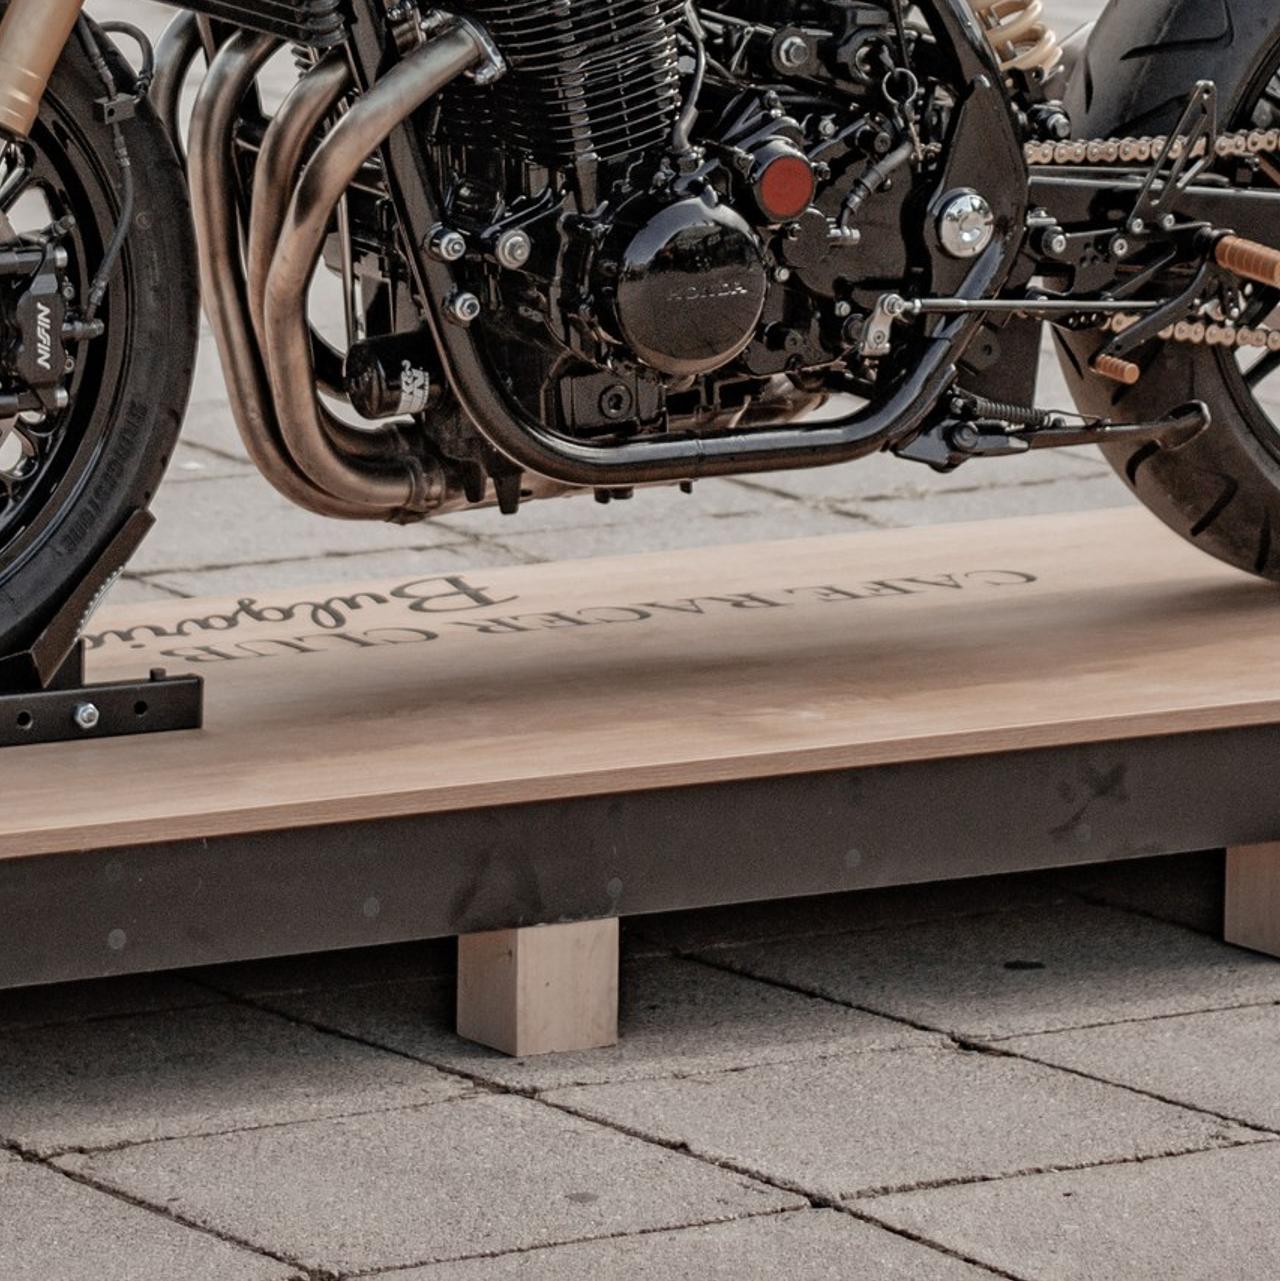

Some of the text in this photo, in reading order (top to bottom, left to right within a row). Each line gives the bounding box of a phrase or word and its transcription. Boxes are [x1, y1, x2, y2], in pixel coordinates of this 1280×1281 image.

[160, 569, 1038, 662] CAFE RACER CLUB
